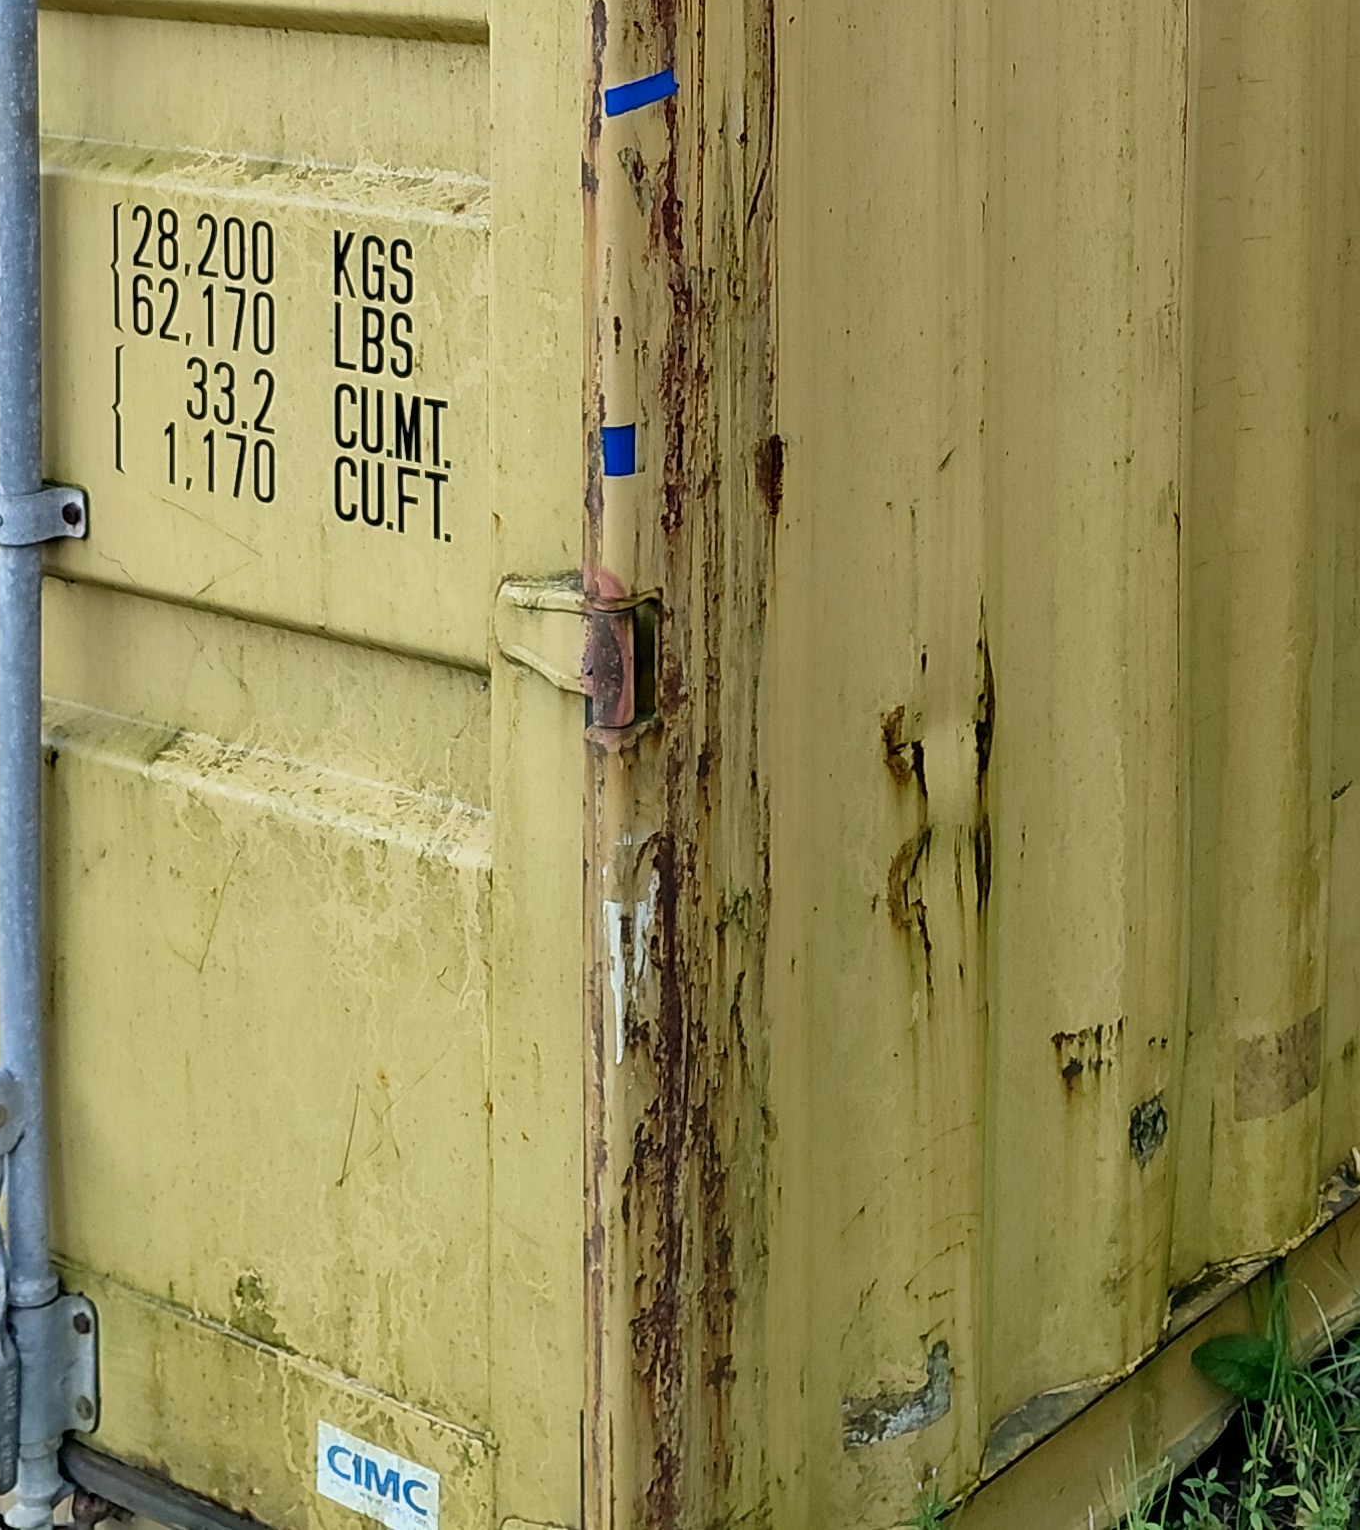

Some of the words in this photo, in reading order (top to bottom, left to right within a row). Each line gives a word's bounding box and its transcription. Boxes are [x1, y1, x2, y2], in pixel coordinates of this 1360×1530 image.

[131, 204, 274, 286] 28,200
[333, 229, 414, 305] KGS
[132, 273, 275, 356] 62,170
[334, 301, 414, 379] LBS
[186, 356, 276, 435] 33.2
[334, 382, 452, 470] CU.MT.
[164, 421, 276, 504] 1,170
[334, 455, 452, 543] CU.FT.
[327, 1445, 429, 1517] CIMC
